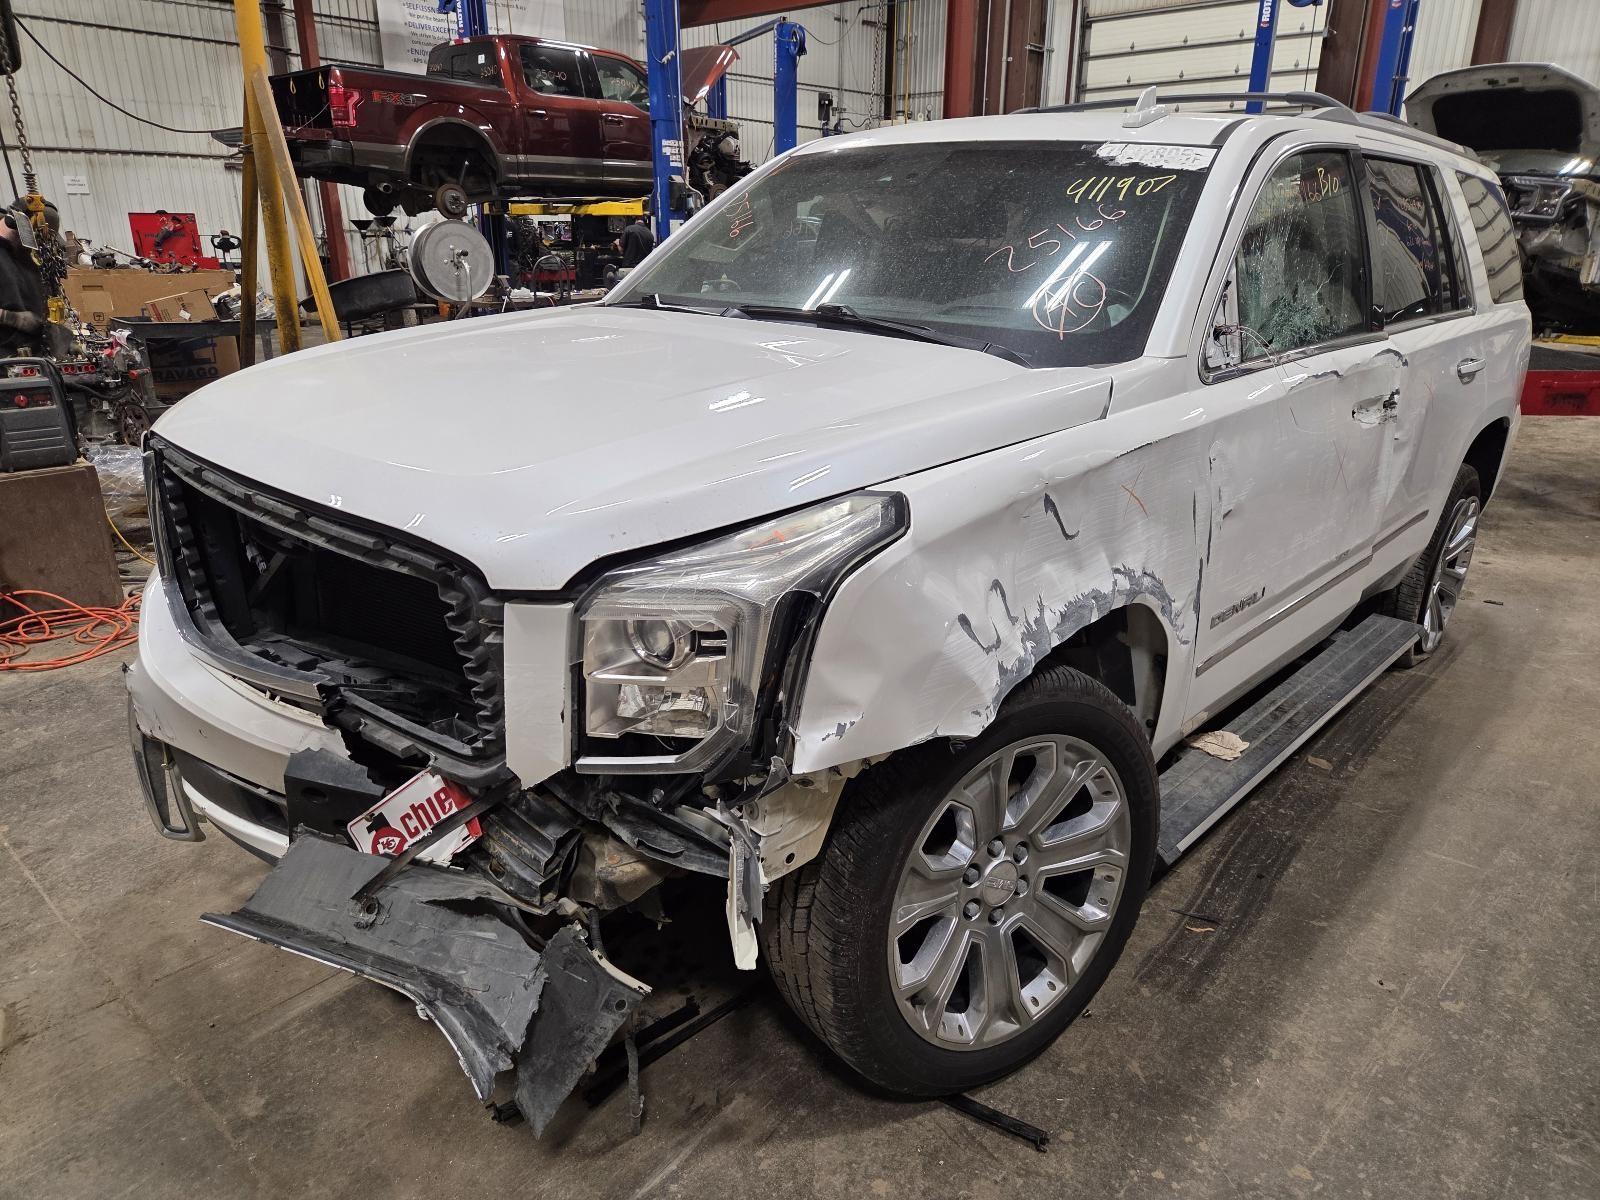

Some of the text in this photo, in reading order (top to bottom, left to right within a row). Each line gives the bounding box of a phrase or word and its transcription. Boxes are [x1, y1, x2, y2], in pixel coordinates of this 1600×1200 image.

[408, 21, 432, 30] DELIVER
[456, 0, 464, 28] ROTA
[1066, 174, 1177, 203] 411907
[1317, 167, 1340, 197] B10
[984, 203, 1126, 272] 25166
[1209, 586, 1266, 631] DENALI
